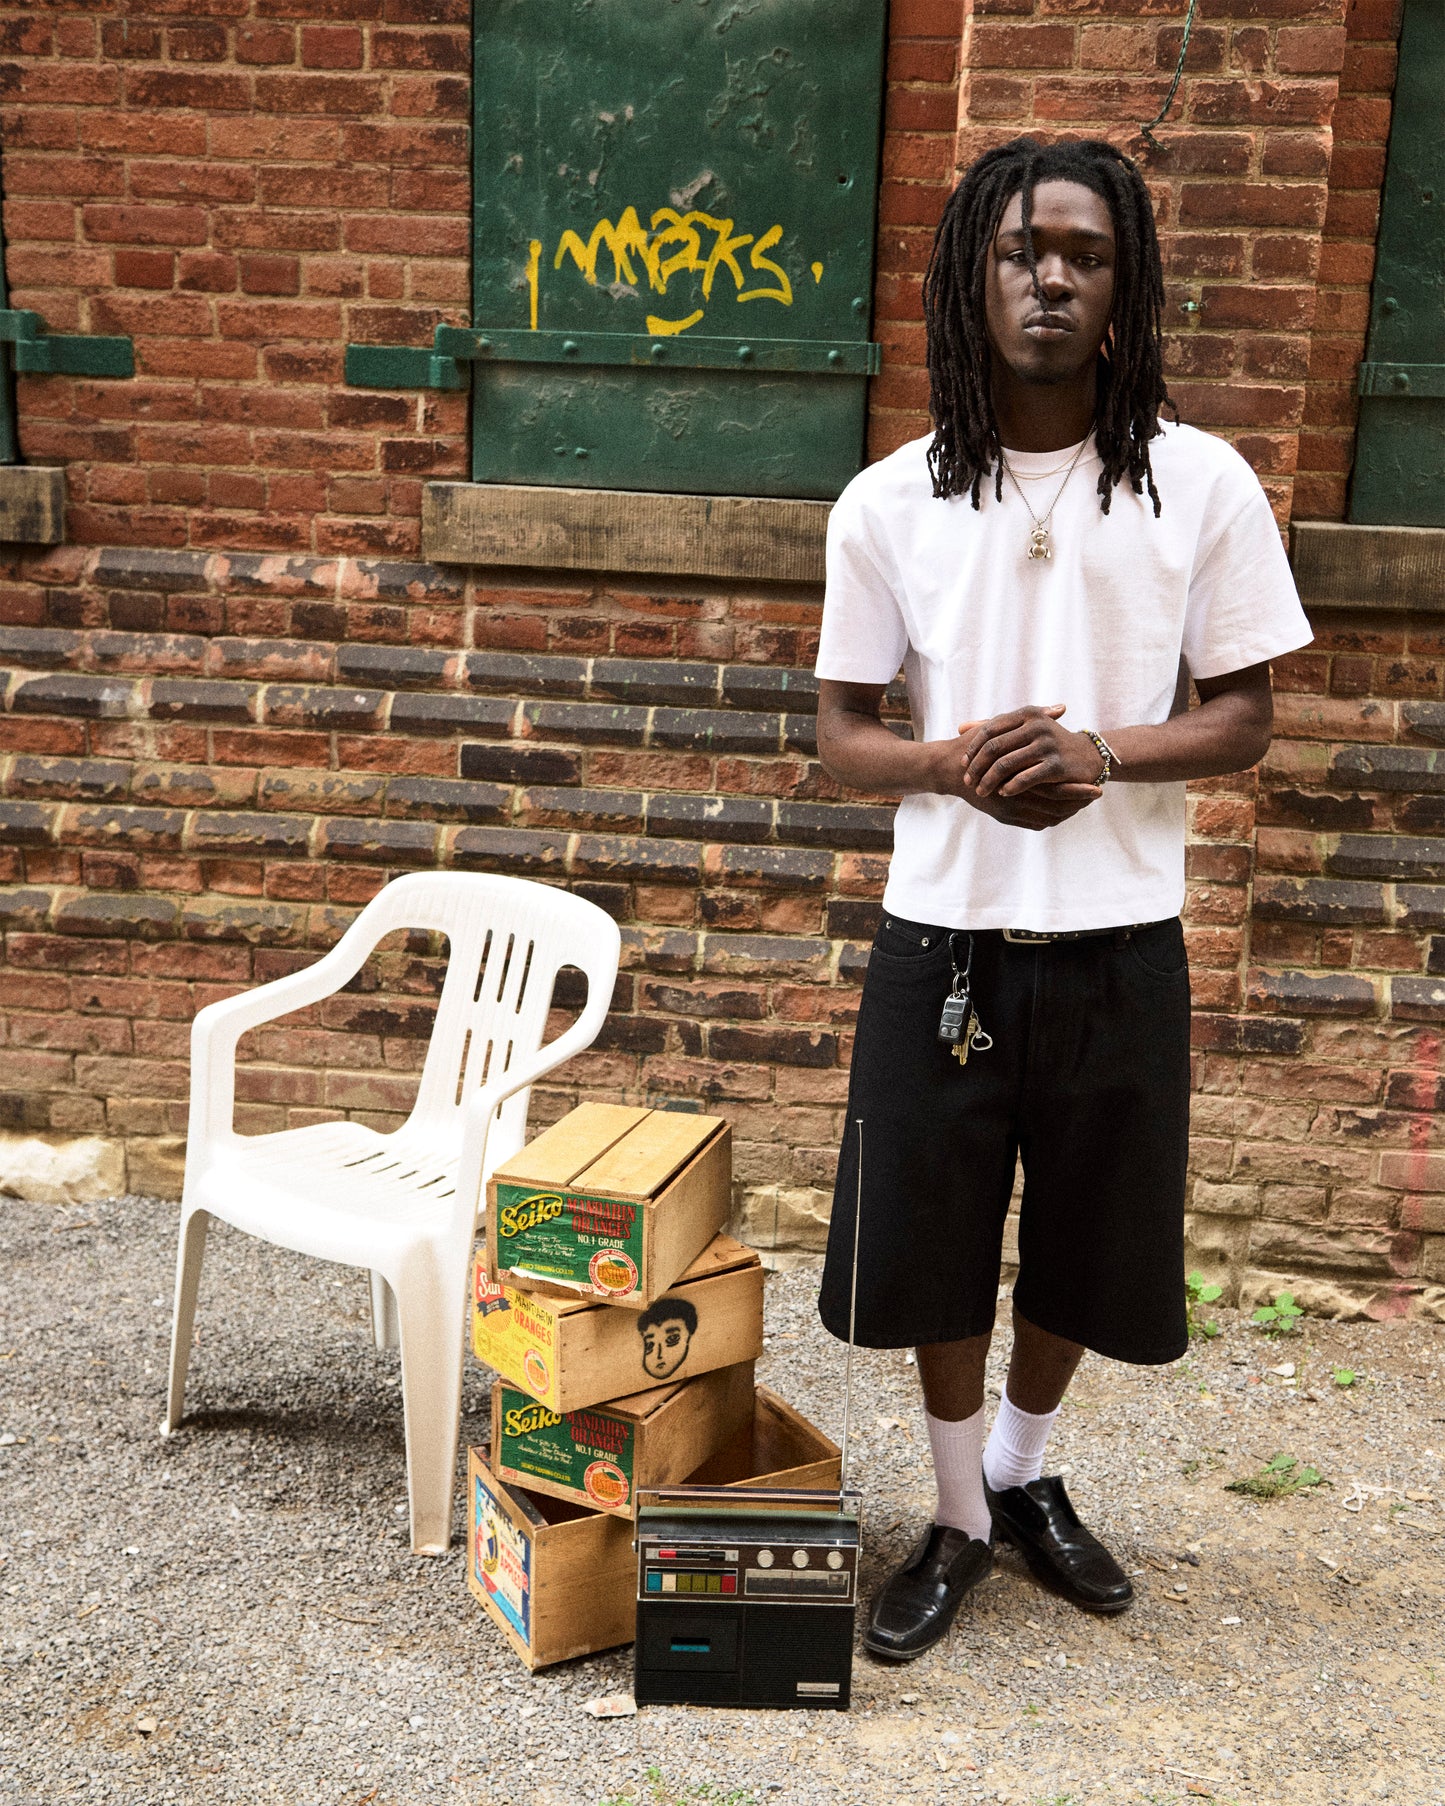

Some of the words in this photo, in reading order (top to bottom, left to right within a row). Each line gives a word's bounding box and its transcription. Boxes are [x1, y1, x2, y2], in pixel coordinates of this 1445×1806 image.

[500, 1193, 563, 1237] Seiko
[566, 1197, 636, 1223] MANDARIN
[572, 1215, 631, 1239] ORANGES
[598, 1237, 625, 1250] GRADE
[478, 1271, 501, 1298] Sun
[515, 1294, 553, 1326] MANDARIN
[514, 1308, 552, 1347] ORANGES
[505, 1403, 562, 1437] Seiko
[566, 1411, 628, 1439] MANDARIN
[571, 1426, 624, 1455] ORANGES
[593, 1449, 618, 1463] GRADE
